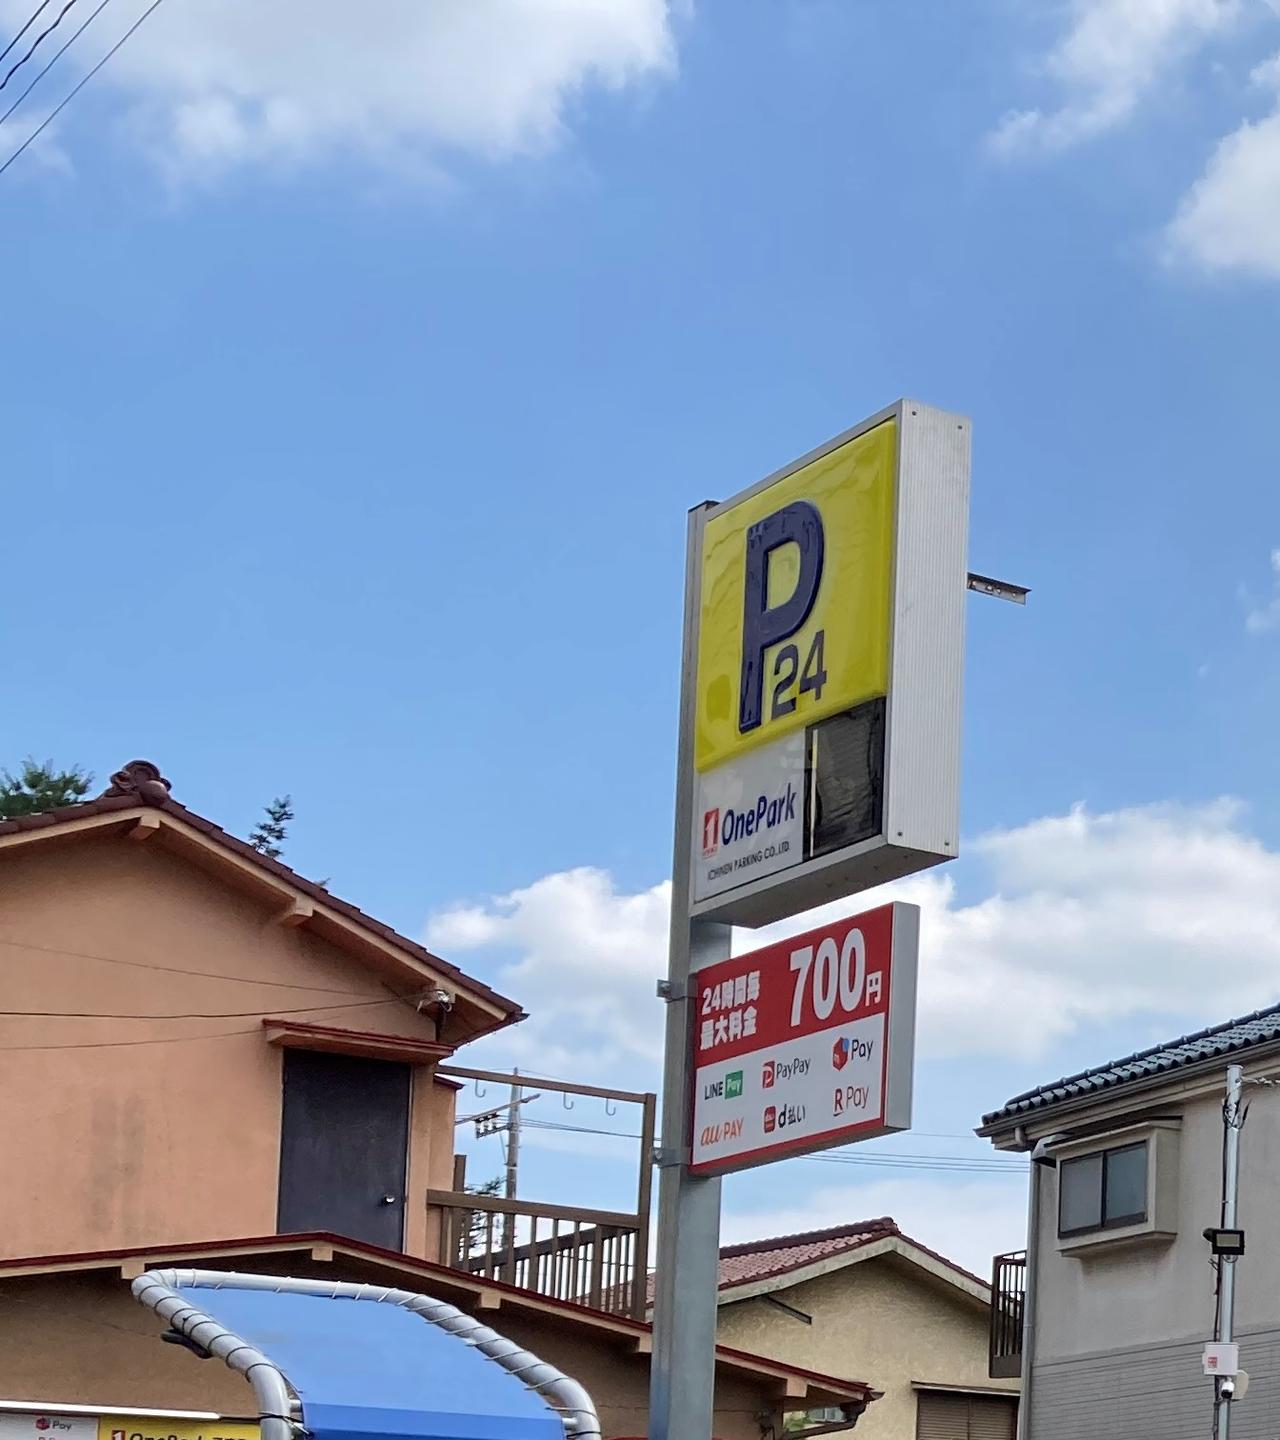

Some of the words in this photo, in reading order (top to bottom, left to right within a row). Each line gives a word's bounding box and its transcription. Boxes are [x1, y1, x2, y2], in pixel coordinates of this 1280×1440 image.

[738, 500, 824, 734] P
[770, 629, 828, 721] 24
[721, 782, 797, 846] OnePark
[733, 850, 763, 873] PARKING
[789, 927, 883, 1028] 700円
[851, 1039, 874, 1061] Pay
[776, 1057, 811, 1080] PayPay
[704, 1081, 724, 1100] LINE
[726, 1078, 742, 1094] Pay
[846, 1085, 870, 1109] Pay
[700, 1126, 721, 1146] au
[723, 1117, 744, 1139] PAY
